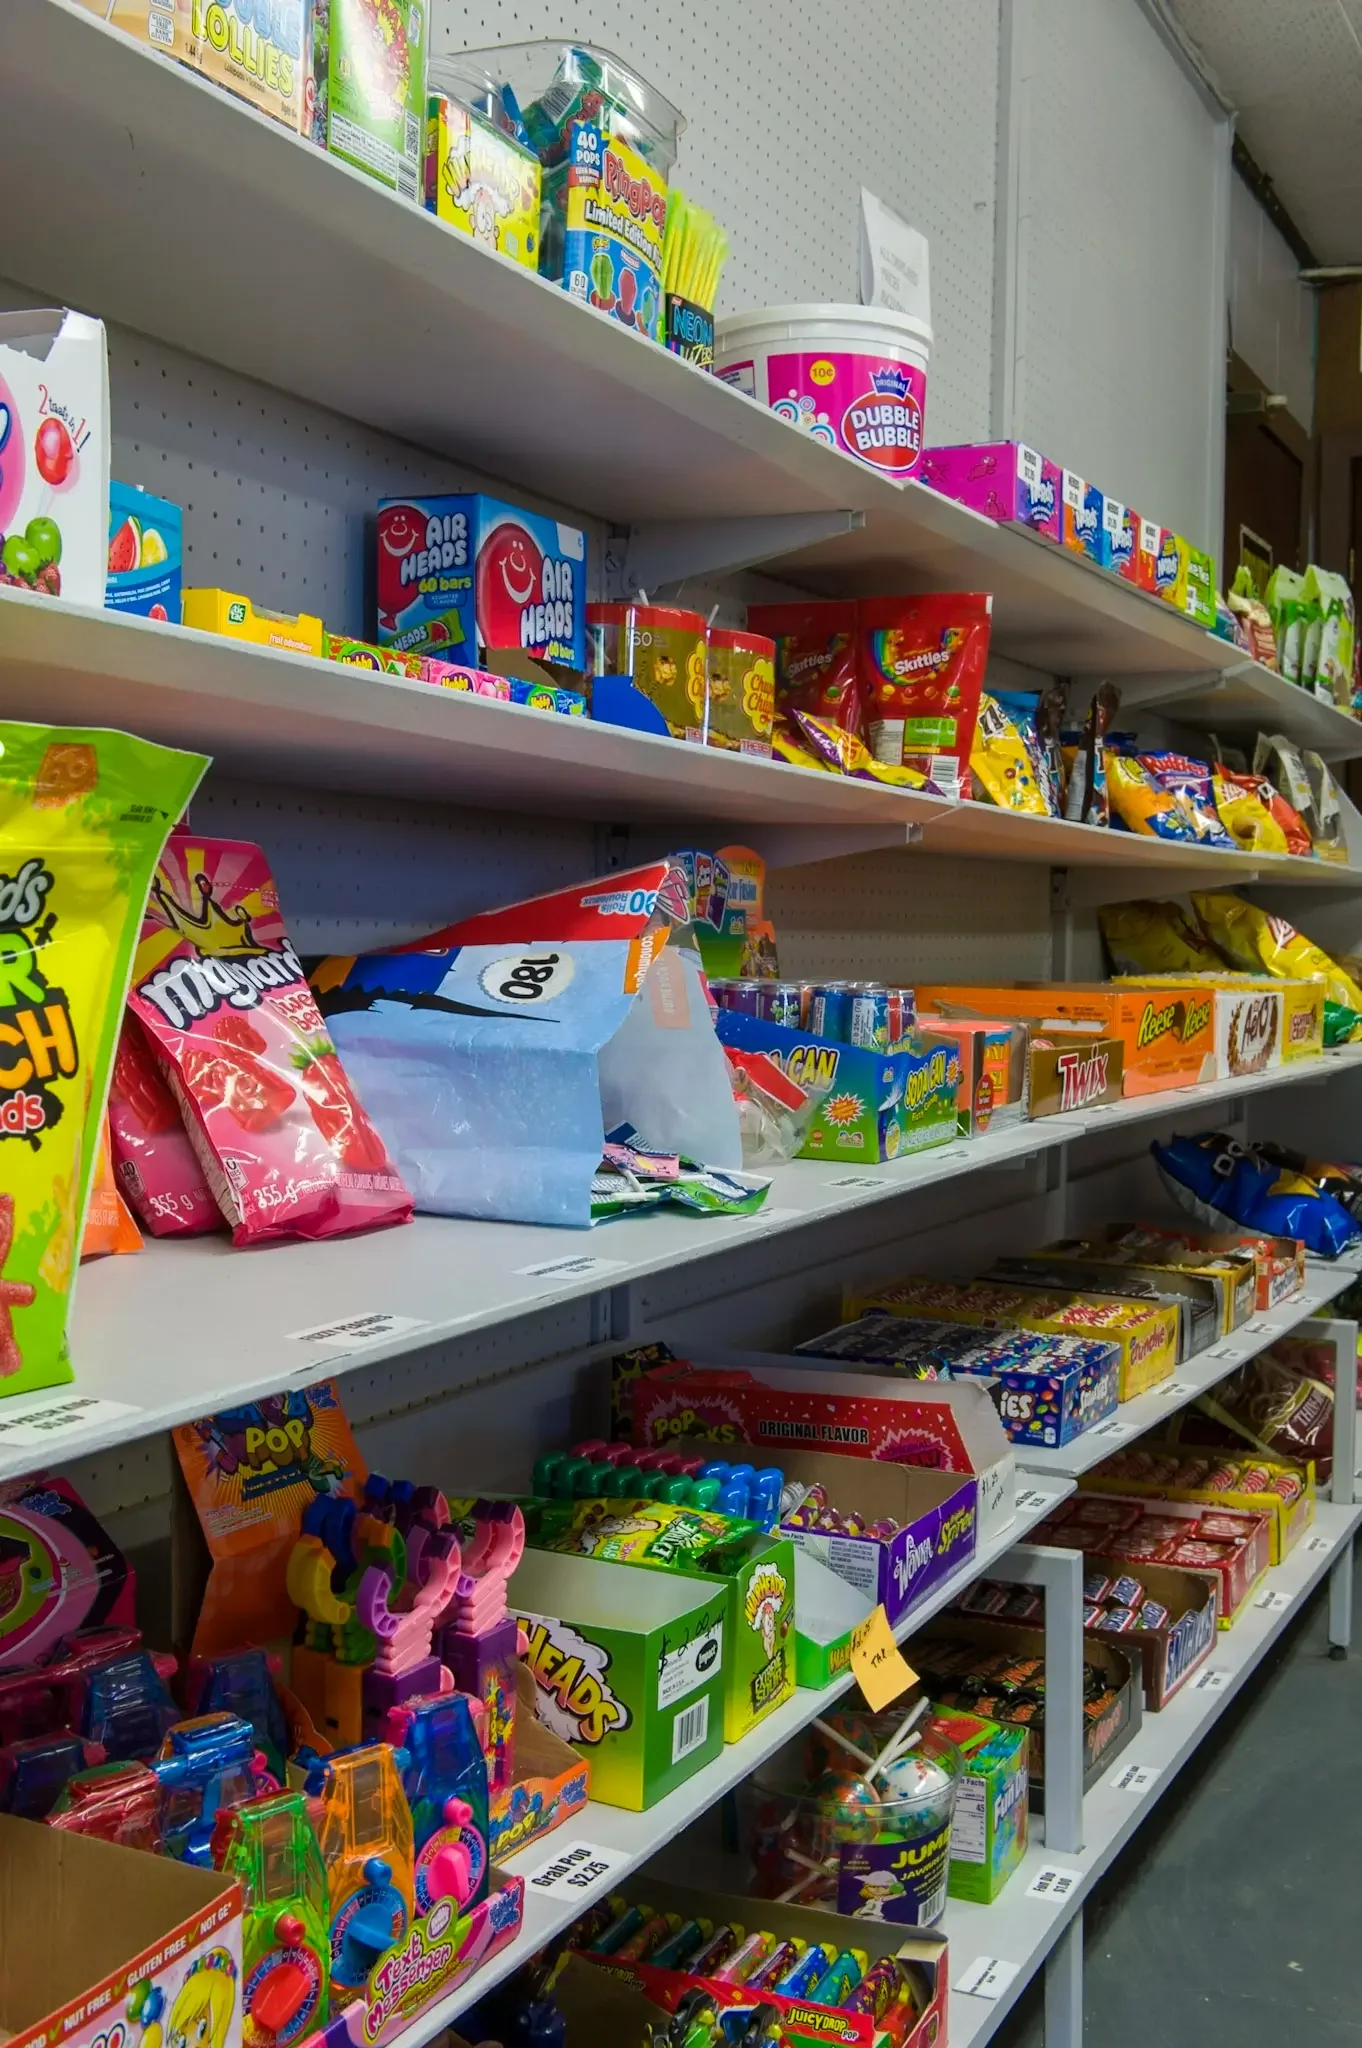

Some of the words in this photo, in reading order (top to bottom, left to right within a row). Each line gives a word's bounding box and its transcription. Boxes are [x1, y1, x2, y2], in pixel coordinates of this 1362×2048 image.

[192, 0, 293, 98] LOLLIES
[577, 131, 597, 150] 40
[576, 151, 600, 166] POPS
[585, 200, 623, 233] Limited
[624, 219, 652, 257] Edition
[575, 273, 586, 287] 60
[673, 306, 713, 345] NEON
[811, 367, 834, 379] 10¢
[875, 377, 906, 393] ORIGINAL
[38, 384, 48, 415] 2
[48, 397, 69, 425] treats
[851, 405, 920, 430] DUBBLE
[856, 426, 920, 452] BUBBLE
[425, 513, 468, 549] AIR
[400, 539, 468, 586] HEADS
[418, 576, 438, 594] 60
[439, 576, 472, 592] bars
[541, 557, 574, 604] AIR
[229, 612, 244, 623] tac
[230, 602, 245, 614] tic
[520, 600, 574, 648] HEADS
[269, 632, 283, 645] fruit
[284, 637, 313, 653] adventure
[548, 640, 559, 657] 60
[559, 647, 575, 661] bars
[787, 653, 832, 679] Skittles
[894, 651, 949, 676] Skittles
[1143, 752, 1210, 778] Ruffles
[600, 903, 625, 912] Rolls
[499, 952, 560, 1000] 180
[1137, 1000, 1176, 1052] Reese
[1181, 998, 1211, 1045] Reese
[787, 1046, 839, 1087] CAN
[905, 1064, 930, 1110] SODA
[929, 1051, 946, 1091] CAN
[149, 1194, 179, 1219] 355
[254, 1187, 284, 1209] 355
[297, 1329, 342, 1341] FUZZY
[333, 1314, 394, 1332] PEACHES
[9, 1409, 65, 1425] PATCH
[654, 1409, 696, 1441] POP
[245, 1419, 305, 1453] POP
[758, 1420, 818, 1440] ORIGINAL
[820, 1426, 870, 1445] FLAVOR
[514, 1618, 620, 1742] HEADS
[967, 1778, 985, 1788] Facts
[976, 1803, 985, 1813] 45
[496, 1811, 536, 1850] POP
[531, 1862, 569, 1887] Grab
[565, 1848, 592, 1868] Pop
[567, 1860, 610, 1888] $2.25
[1040, 1872, 1056, 1883] Dip
[1033, 1880, 1048, 1893] Fun
[63, 2006, 85, 2034] NUT
[86, 1991, 112, 2018] FREE
[127, 1954, 163, 1988] GLUTEN
[163, 1935, 188, 1962] FREE
[199, 1913, 218, 1935] NOT
[375, 1930, 424, 1994] Text
[366, 1943, 452, 2040] Messenger
[786, 2007, 822, 2030] JUICY
[821, 2015, 849, 2035] DROP
[842, 2030, 859, 2042] POP
